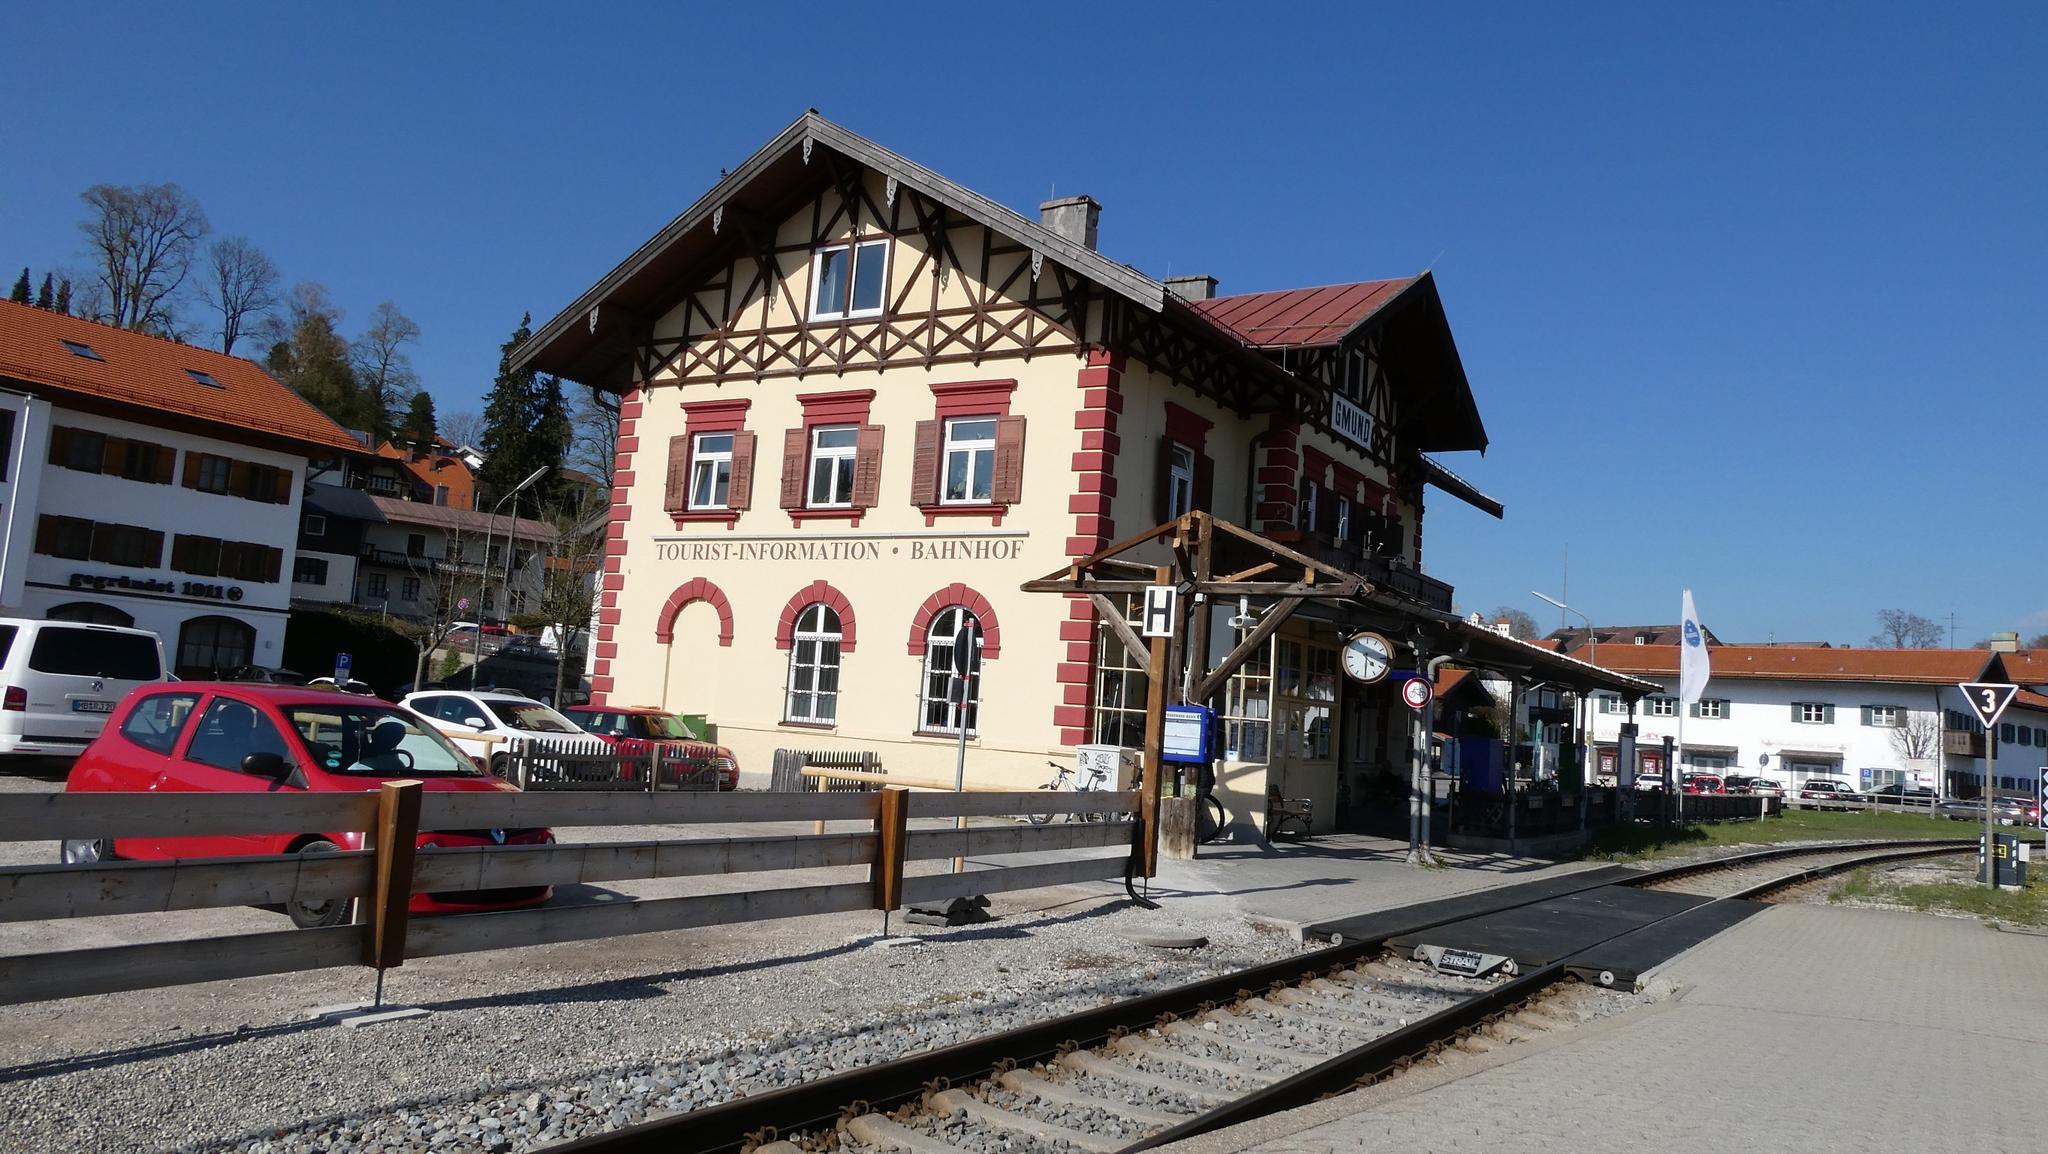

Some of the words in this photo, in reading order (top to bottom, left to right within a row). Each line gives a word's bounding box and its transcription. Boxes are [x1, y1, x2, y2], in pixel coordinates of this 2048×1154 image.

[1335, 400, 1370, 443] GMUND
[656, 541, 880, 560] TOURIST-INFORMATION
[911, 540, 1024, 560] BAHNHOF
[69, 573, 176, 594] gegründet
[181, 581, 224, 599] 1911
[1147, 590, 1172, 632] H
[340, 655, 348, 667] P
[1981, 689, 1996, 713] 3
